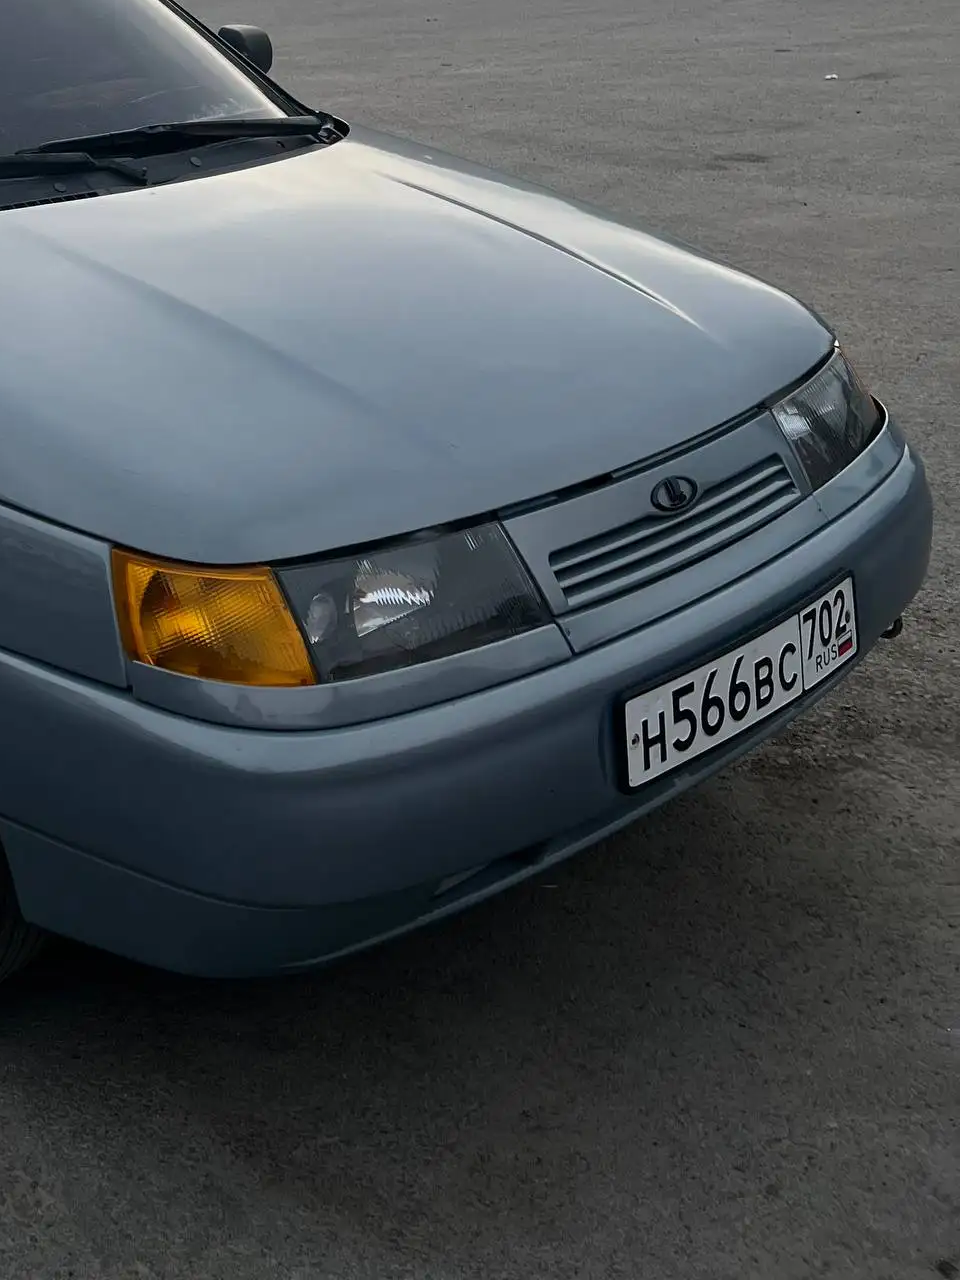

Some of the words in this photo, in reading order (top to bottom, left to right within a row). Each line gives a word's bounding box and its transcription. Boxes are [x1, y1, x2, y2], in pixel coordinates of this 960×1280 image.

[641, 642, 798, 771] Н566ВС
[802, 589, 847, 660] 702
[816, 644, 838, 673] RUS
